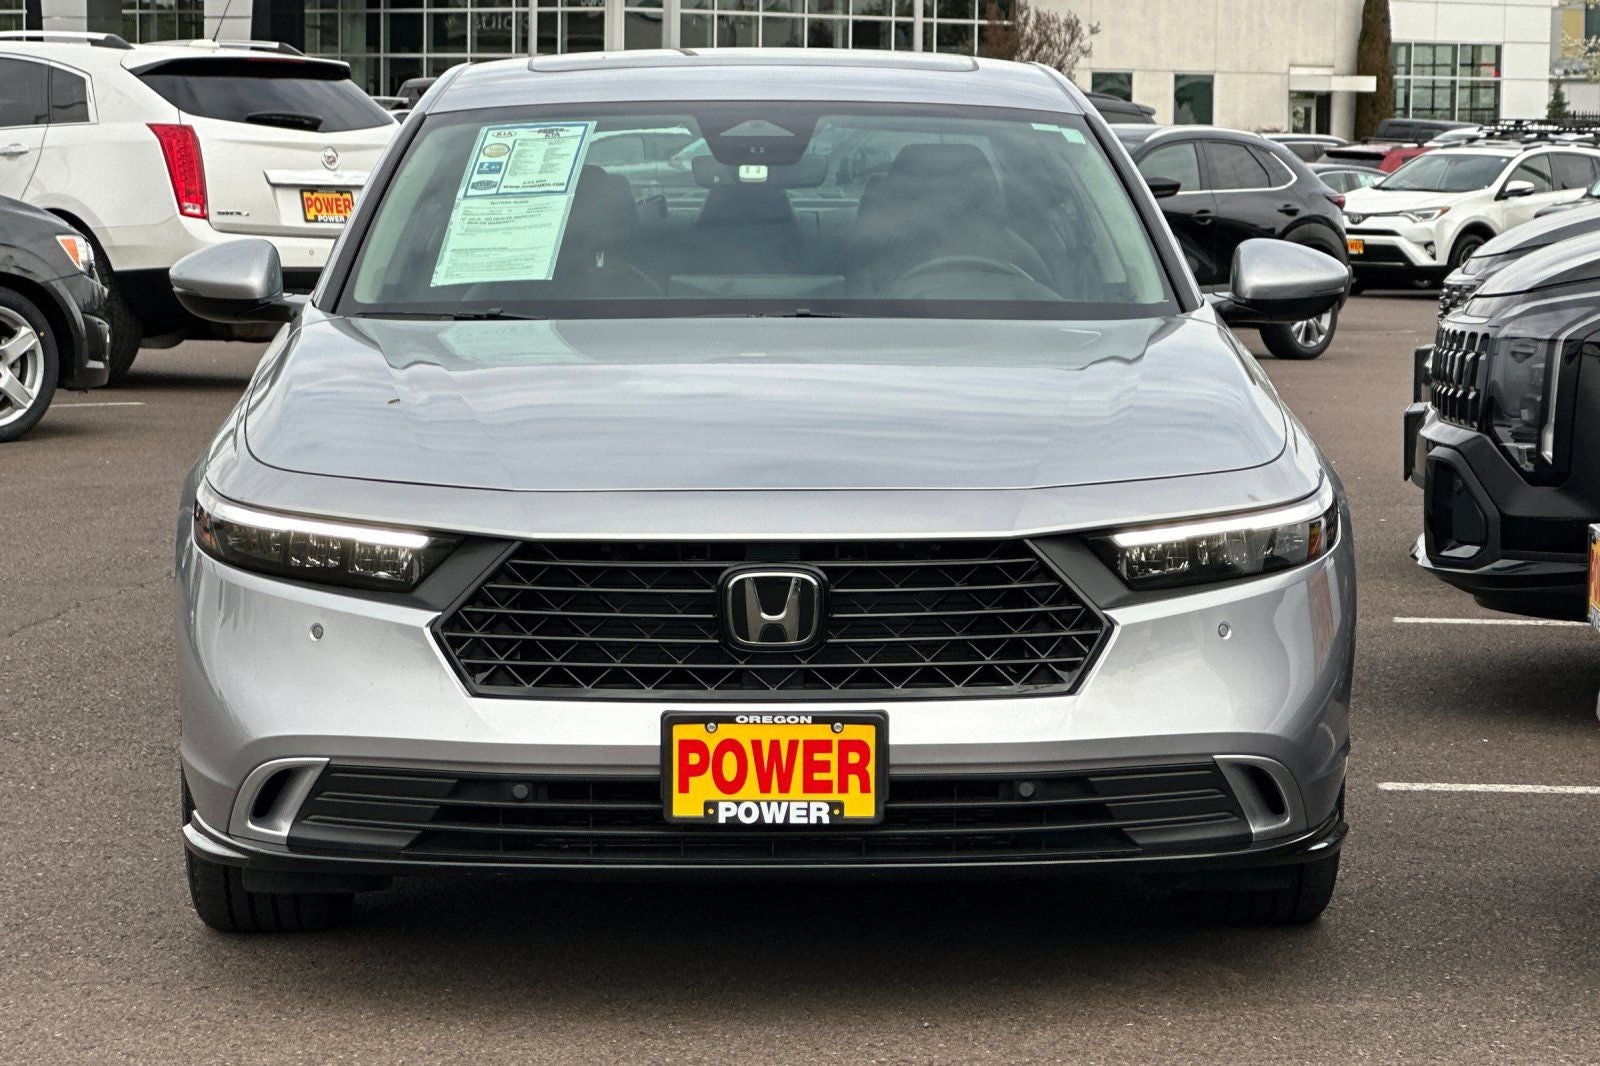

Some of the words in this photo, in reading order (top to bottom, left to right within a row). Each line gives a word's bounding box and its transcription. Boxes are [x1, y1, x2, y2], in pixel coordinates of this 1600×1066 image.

[305, 196, 352, 214] POWER
[318, 214, 346, 223] POWER
[735, 715, 813, 724] OREGON
[678, 739, 871, 795] POWER
[718, 801, 830, 825] POWER
